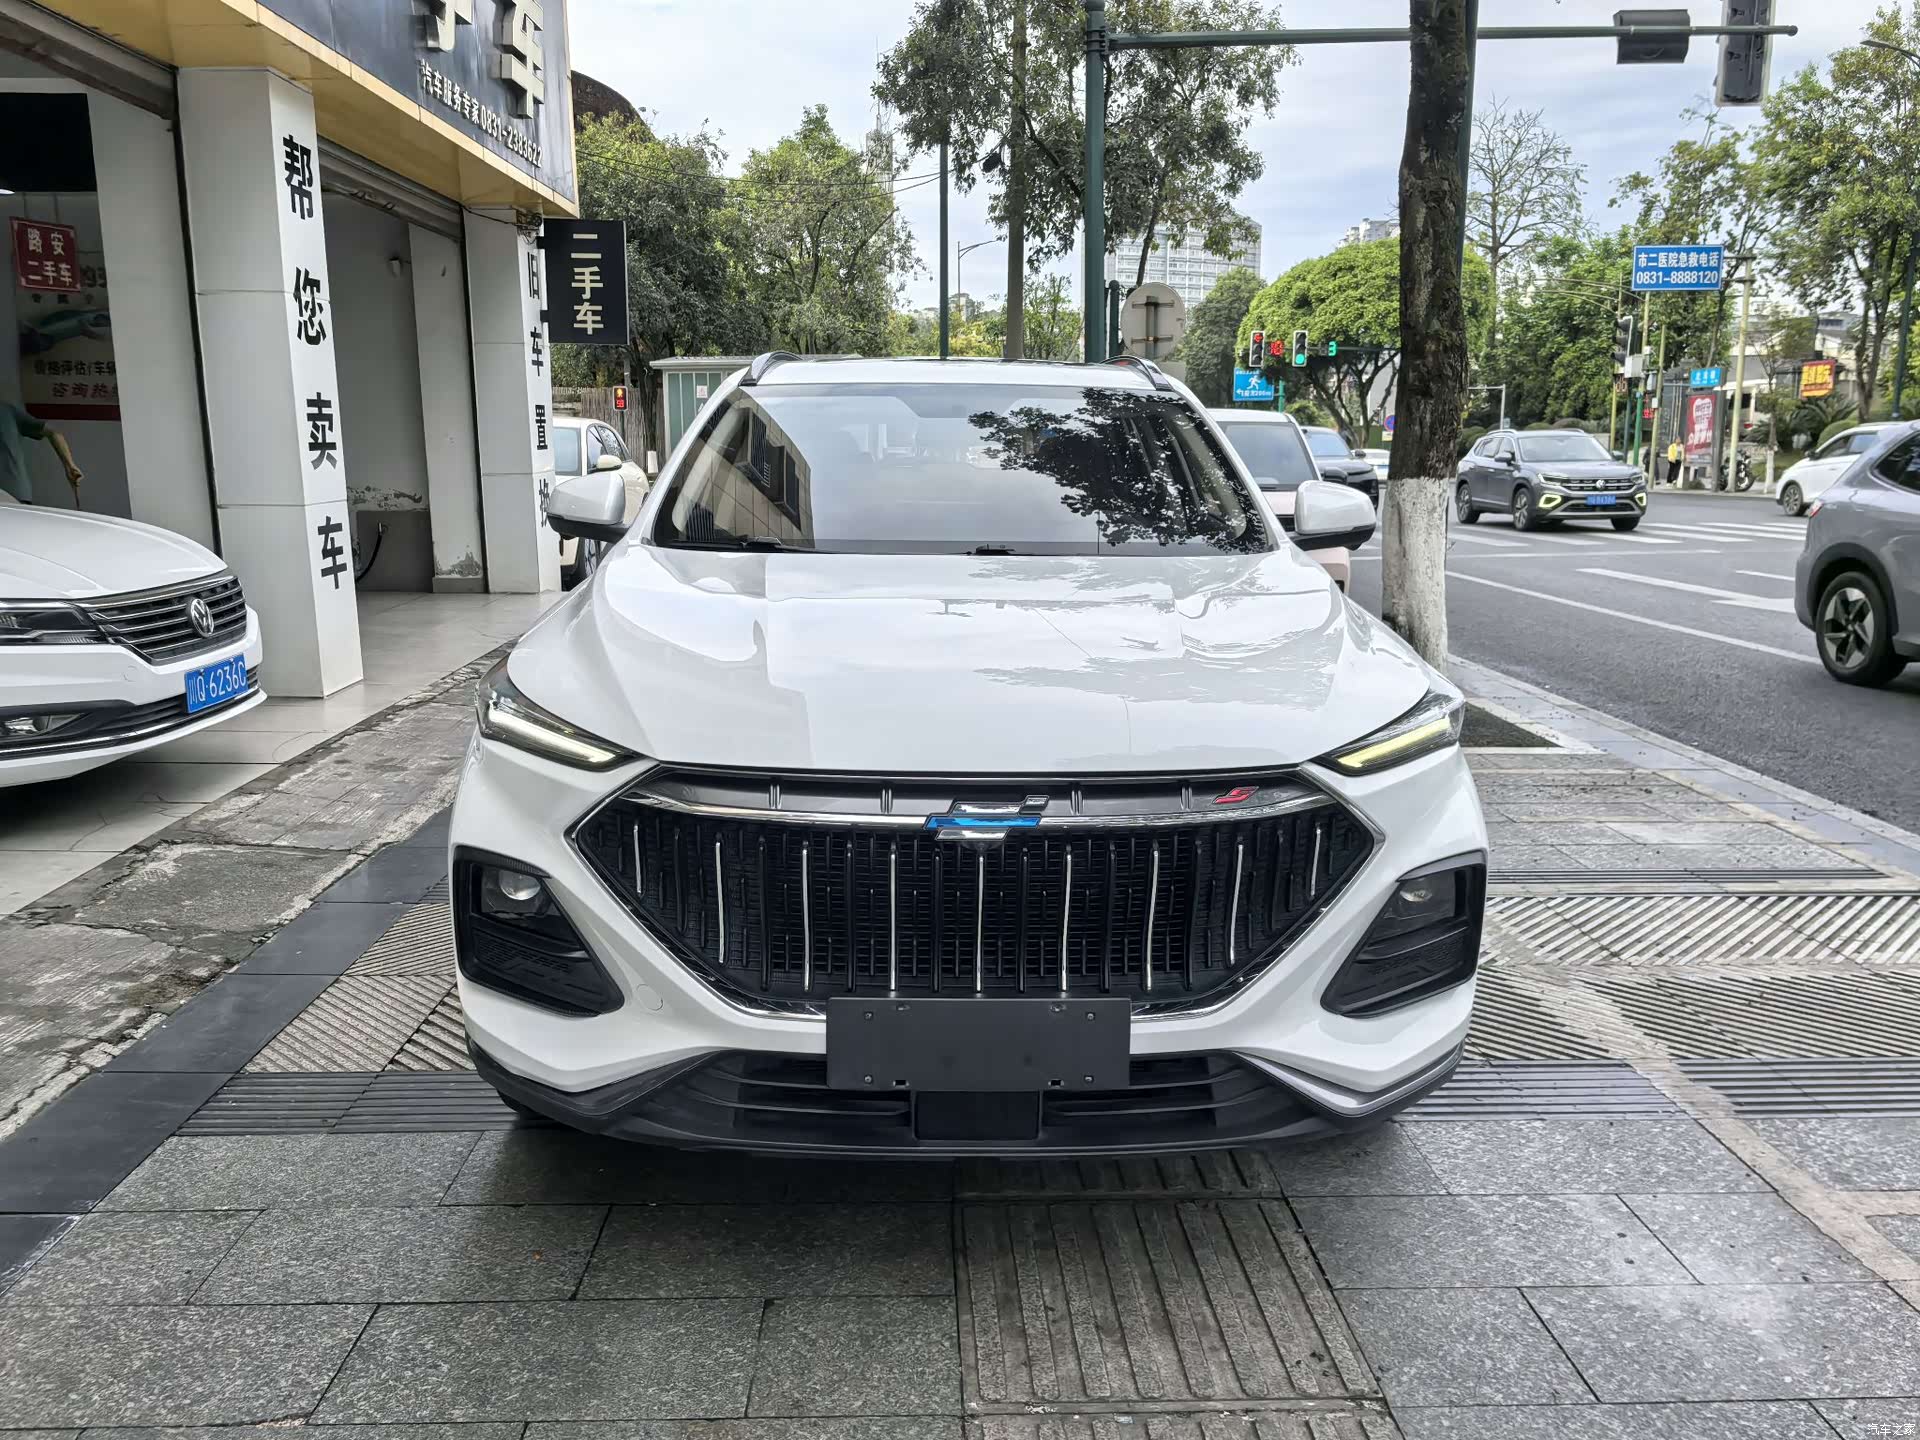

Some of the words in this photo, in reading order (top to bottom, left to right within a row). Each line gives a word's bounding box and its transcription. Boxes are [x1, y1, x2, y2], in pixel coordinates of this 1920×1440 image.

[420, 59, 480, 125] 汽车服务专家
[481, 105, 543, 168] 0831-2383622
[1638, 251, 1719, 268] 市二医院急救电话
[27, 260, 73, 287] 二手车
[571, 233, 604, 336] 二手车
[1636, 271, 1718, 285] 0831-8888120
[282, 134, 348, 590] 帮您卖车
[1328, 341, 1337, 356] 3
